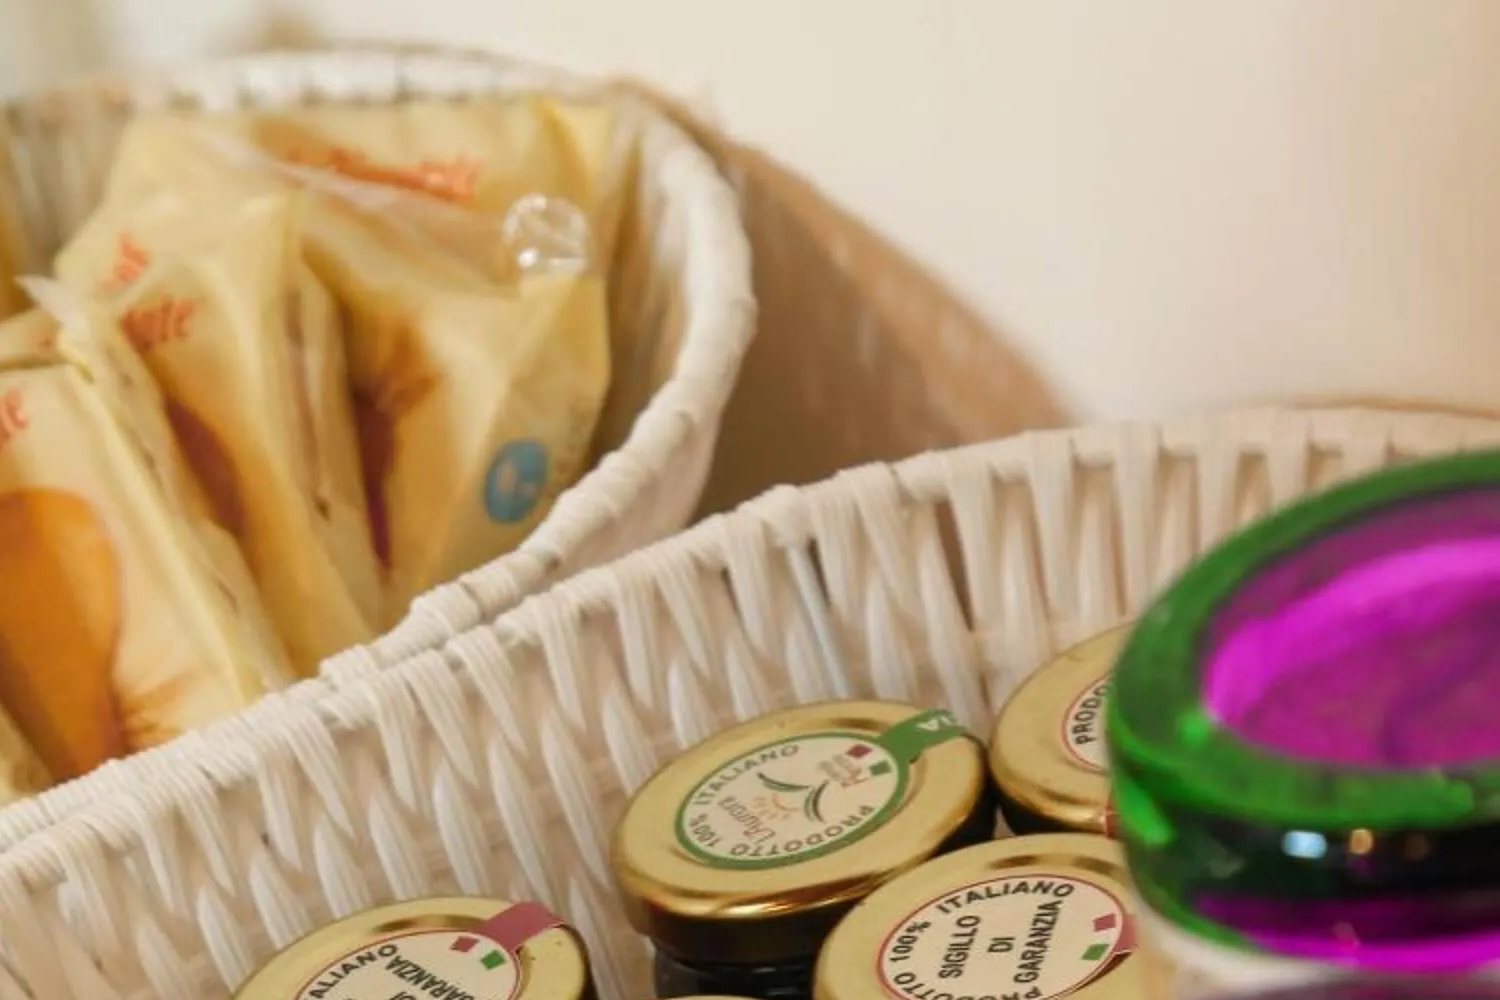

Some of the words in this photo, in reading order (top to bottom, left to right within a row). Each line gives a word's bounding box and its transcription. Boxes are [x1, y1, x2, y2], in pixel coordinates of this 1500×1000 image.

[694, 745, 800, 805] ITALIANO
[730, 805, 875, 857] PRODOTTO
[890, 920, 931, 963] 100%
[936, 881, 1075, 915] ITALIANO
[938, 915, 981, 979] SIGILLO
[987, 936, 1015, 953] DI
[1013, 900, 1063, 983] GARANZIA
